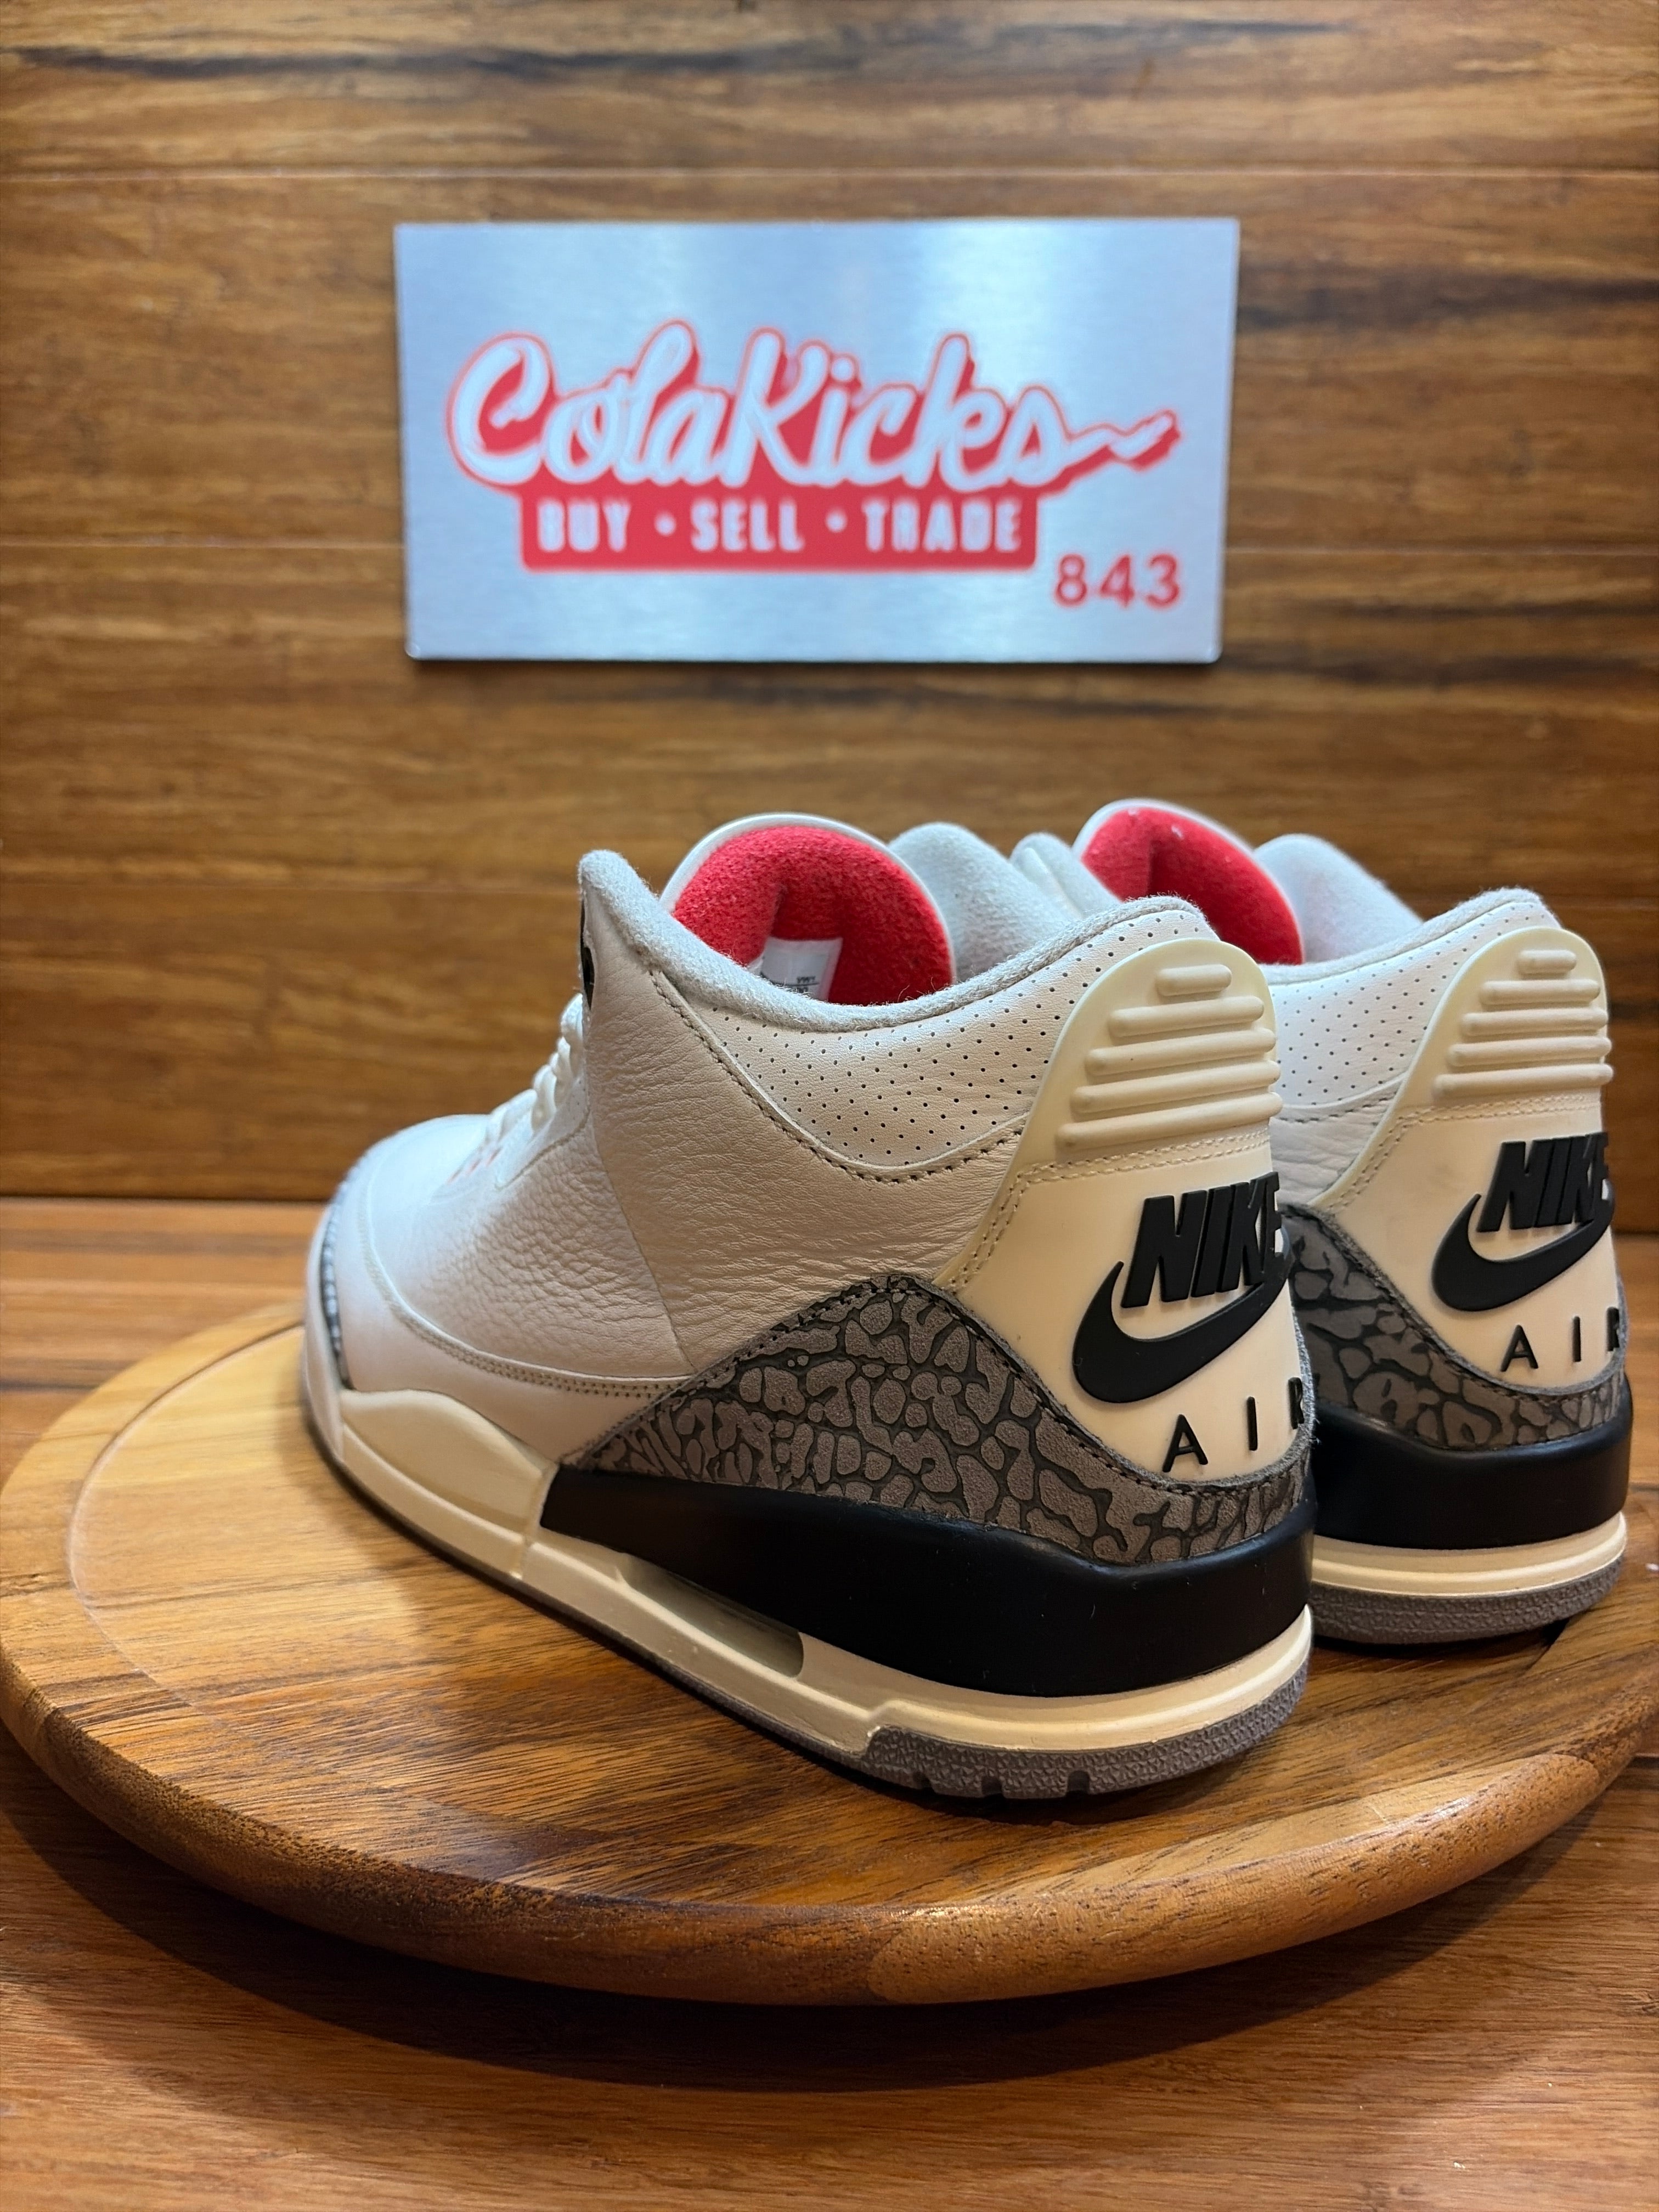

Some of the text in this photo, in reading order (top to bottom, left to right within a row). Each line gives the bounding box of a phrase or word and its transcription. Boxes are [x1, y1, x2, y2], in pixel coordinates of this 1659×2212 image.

[447, 320, 1178, 490] ColaKicks
[537, 498, 1022, 552] BUY SELL TRADE
[1053, 553, 1181, 608] 843
[1477, 1132, 1609, 1233] NIKE
[1121, 1172, 1282, 1309] NIKE
